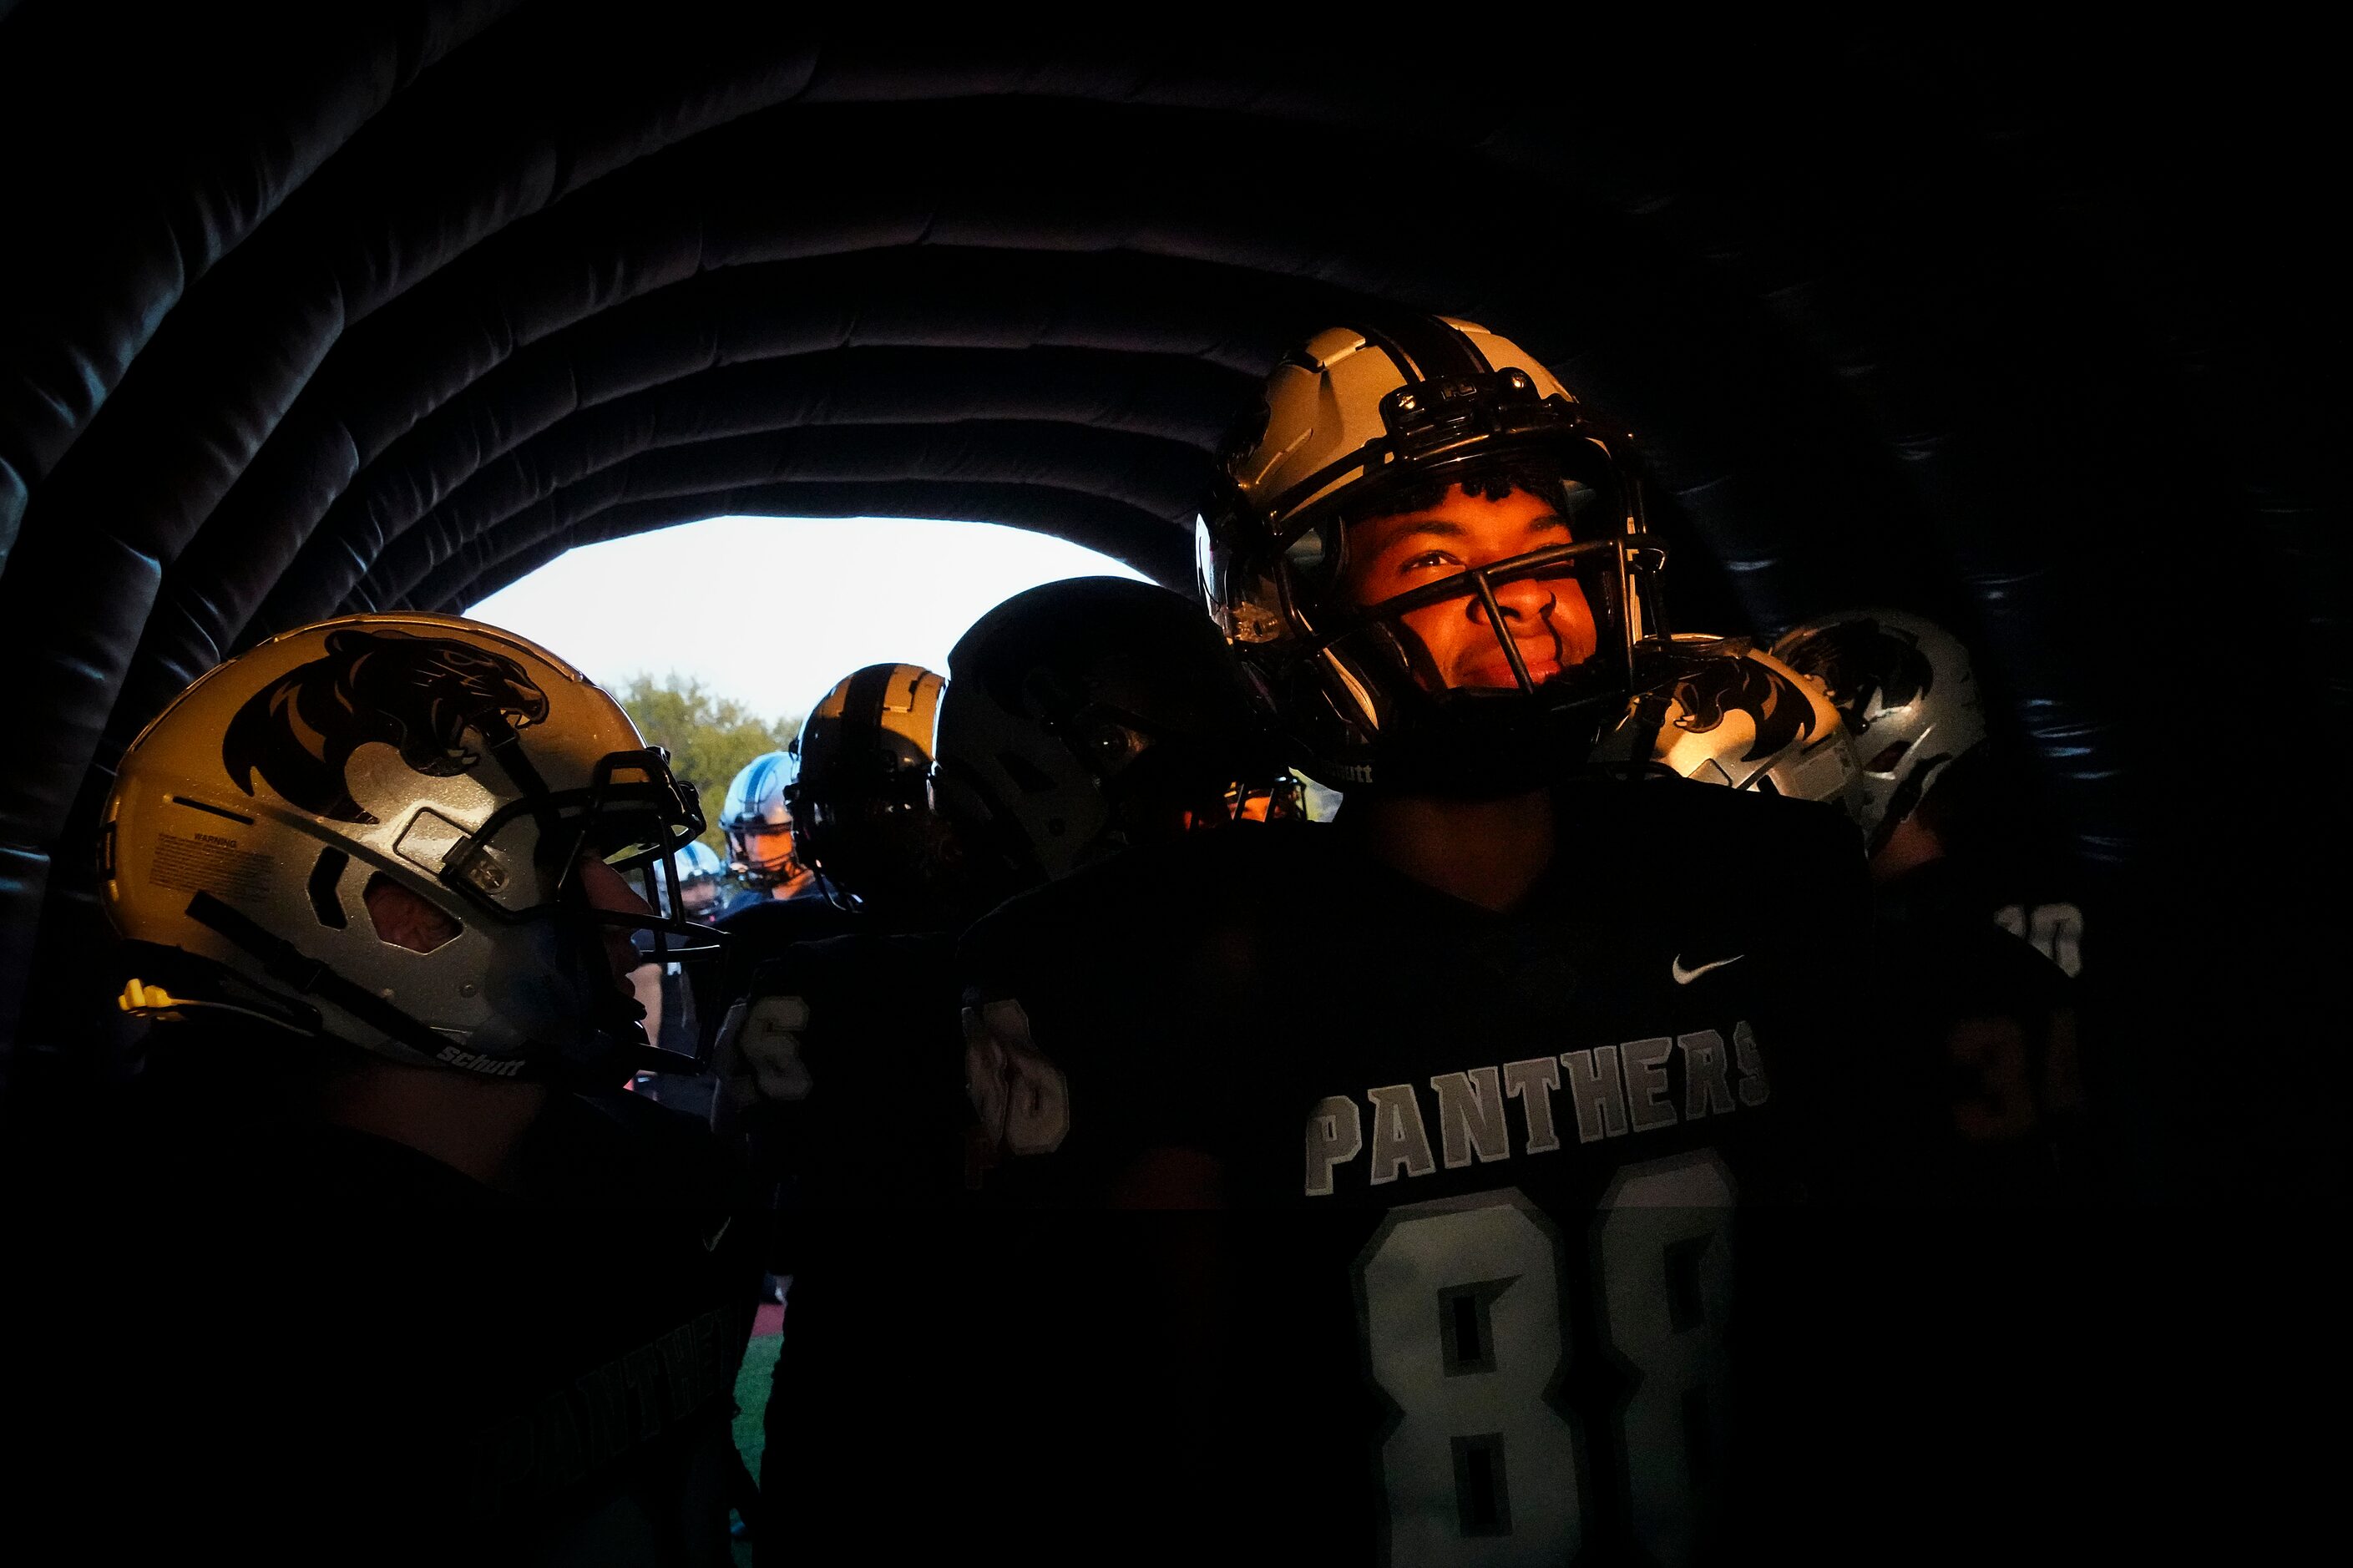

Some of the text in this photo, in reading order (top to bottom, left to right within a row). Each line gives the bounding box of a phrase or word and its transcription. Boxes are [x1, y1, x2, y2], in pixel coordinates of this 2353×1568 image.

[194, 833, 237, 848] WARNING
[1304, 1019, 1771, 1197] PANTHERS
[1347, 1147, 1741, 1568] 88
